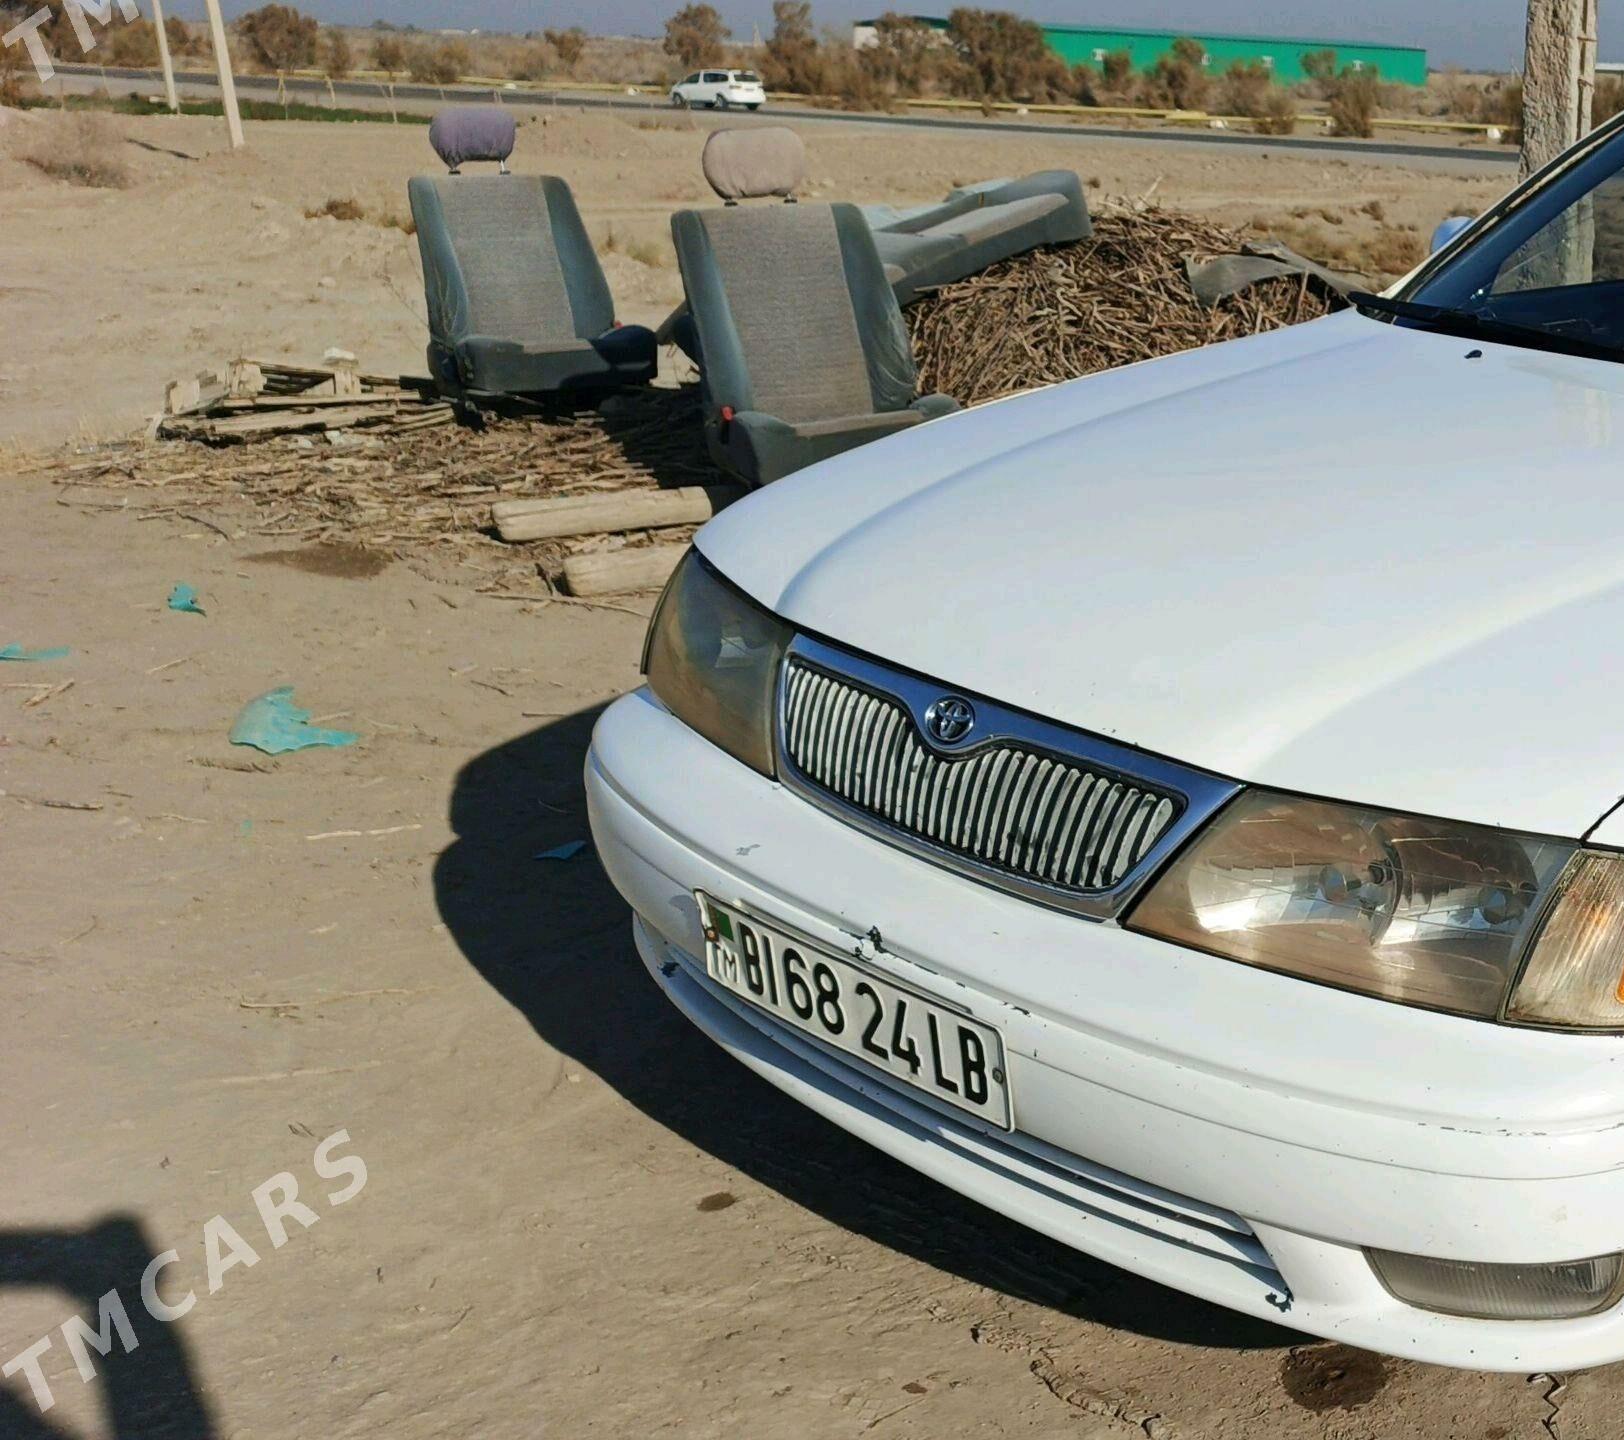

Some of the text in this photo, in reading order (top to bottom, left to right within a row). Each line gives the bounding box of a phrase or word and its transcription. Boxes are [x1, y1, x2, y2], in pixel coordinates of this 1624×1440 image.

[783, 947, 846, 1036] 68
[855, 981, 922, 1076] 24
[927, 1011, 989, 1106] LB
